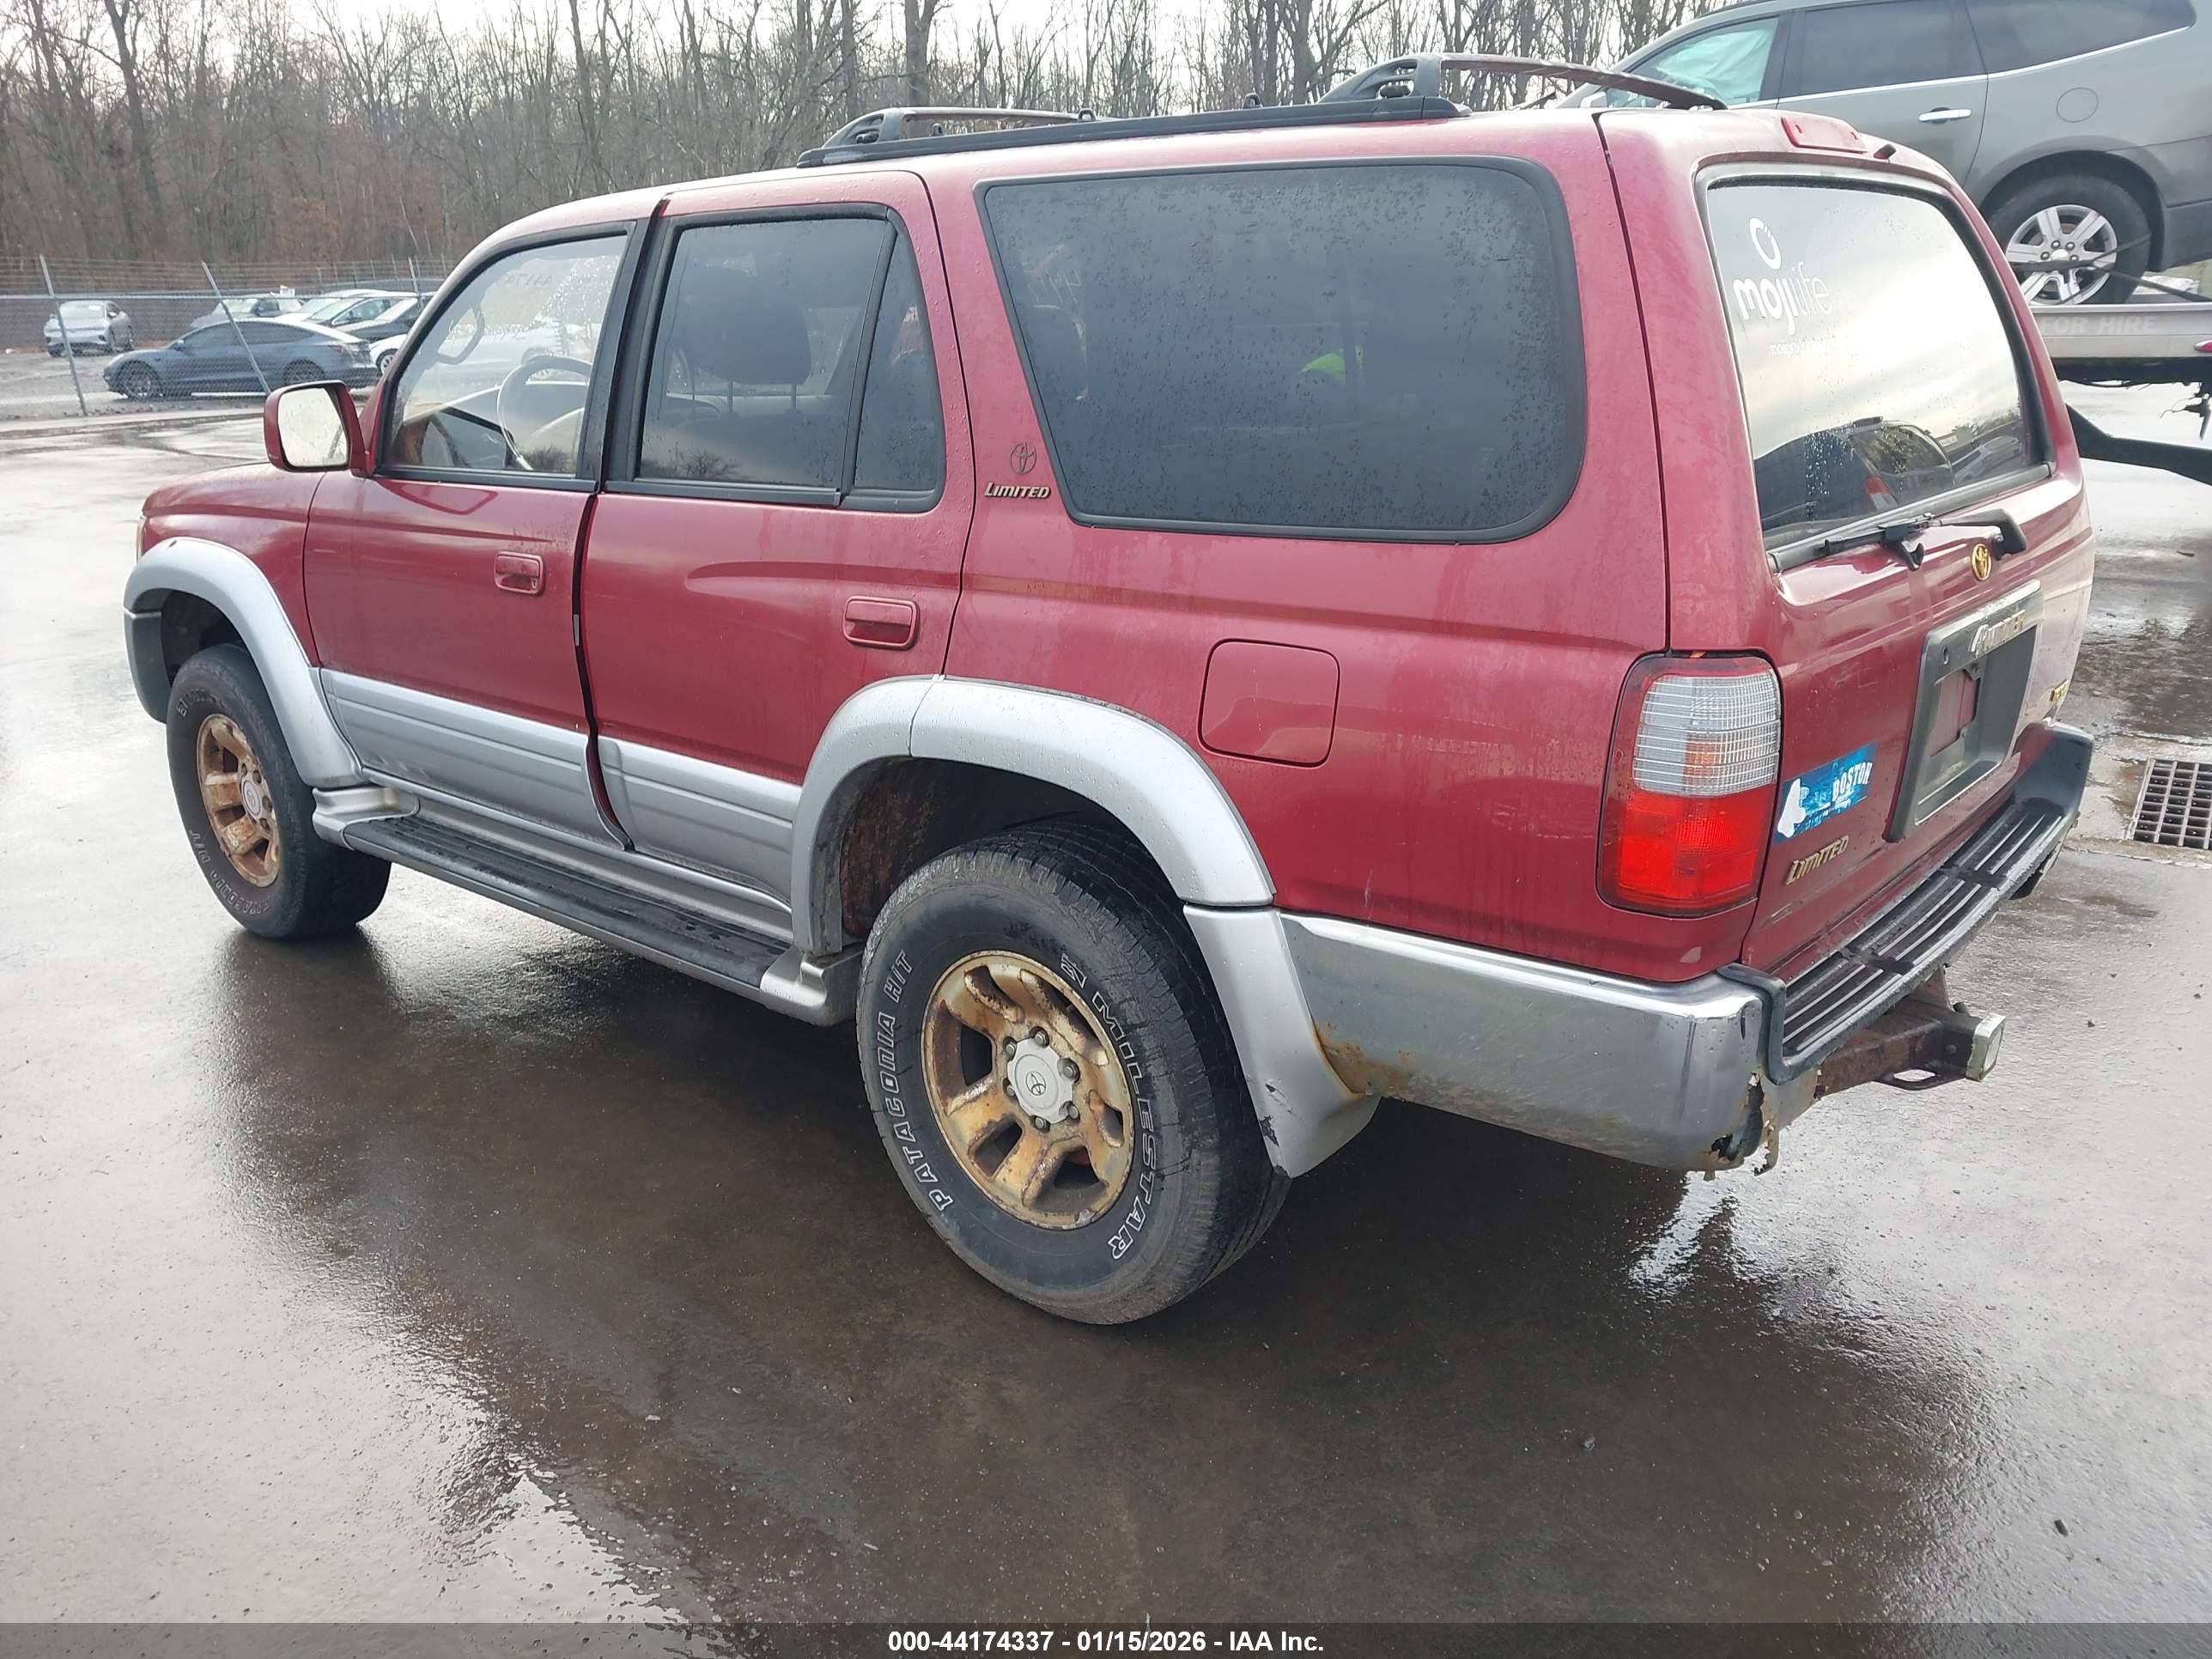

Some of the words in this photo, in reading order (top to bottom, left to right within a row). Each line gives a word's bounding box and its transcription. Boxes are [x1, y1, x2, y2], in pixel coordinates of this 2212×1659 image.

[2039, 315, 2088, 333] FOR
[2097, 315, 2159, 333] HIRE
[983, 482, 1051, 498] LIMITED
[1832, 762, 1873, 802] BOSTON
[878, 1012, 953, 1211] PATAGONIA
[1091, 991, 1157, 1260] MILESTAR
